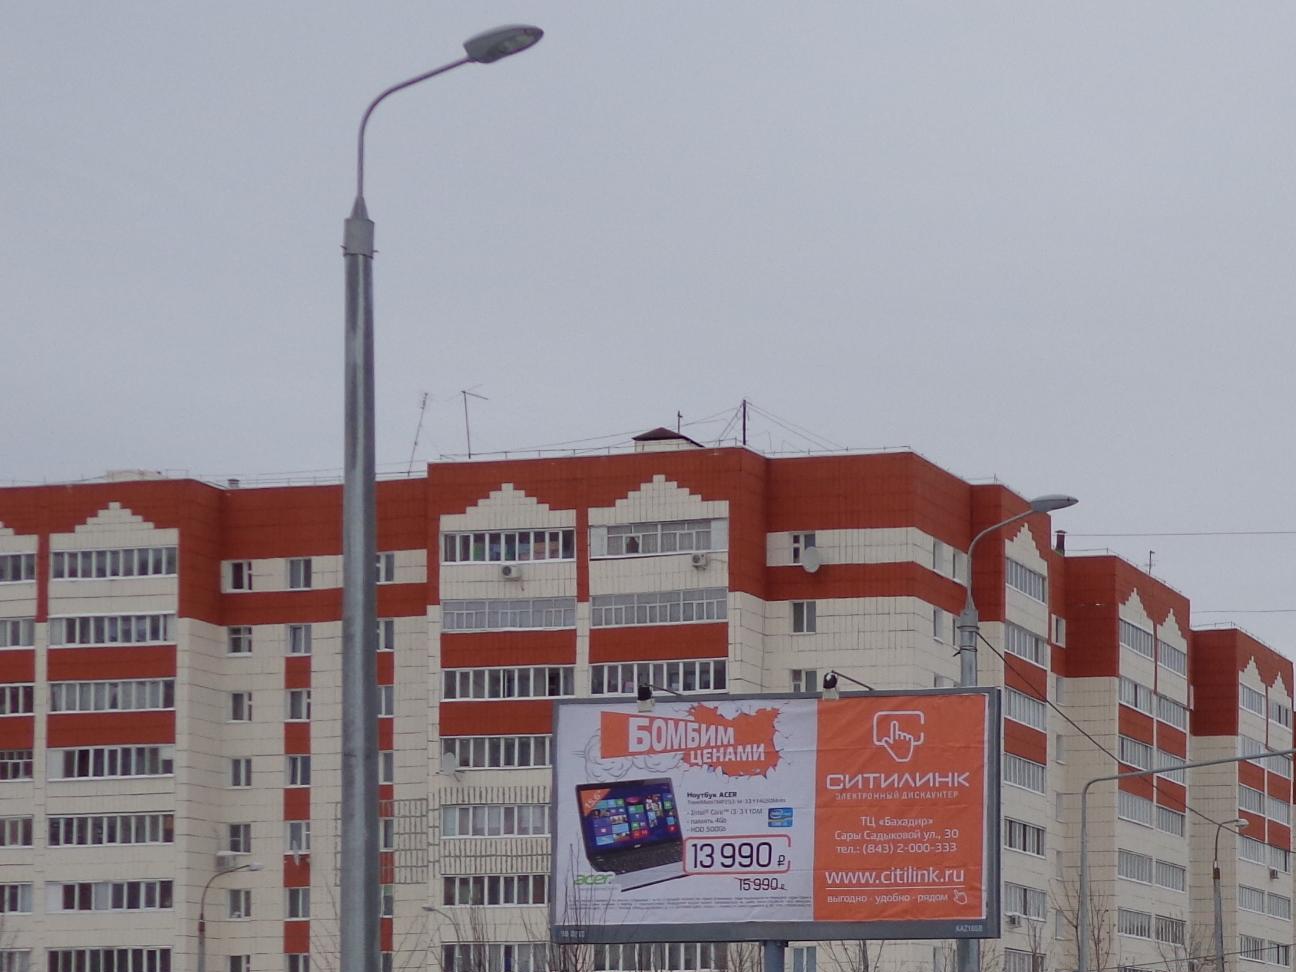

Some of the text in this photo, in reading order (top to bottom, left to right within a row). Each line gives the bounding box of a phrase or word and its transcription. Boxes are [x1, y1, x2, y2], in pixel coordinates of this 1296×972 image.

[628, 717, 735, 753] БОМБИМ
[690, 743, 765, 765] ЦЕНАМИ
[826, 772, 970, 790] СИТИЛИНК
[835, 790, 959, 800] ЭЛЕКТРОННЫЙ ДИСКАУНТЕР
[860, 816, 934, 827] ТЦ «Бахадир»
[834, 830, 862, 841] Сары
[863, 829, 921, 841] Садыковой
[944, 829, 959, 839] 30
[835, 842, 958, 855] тел.: (843) 2-000-333
[825, 866, 965, 885] www.citilink.ru
[827, 893, 949, 905] выгодно удобно рядом
